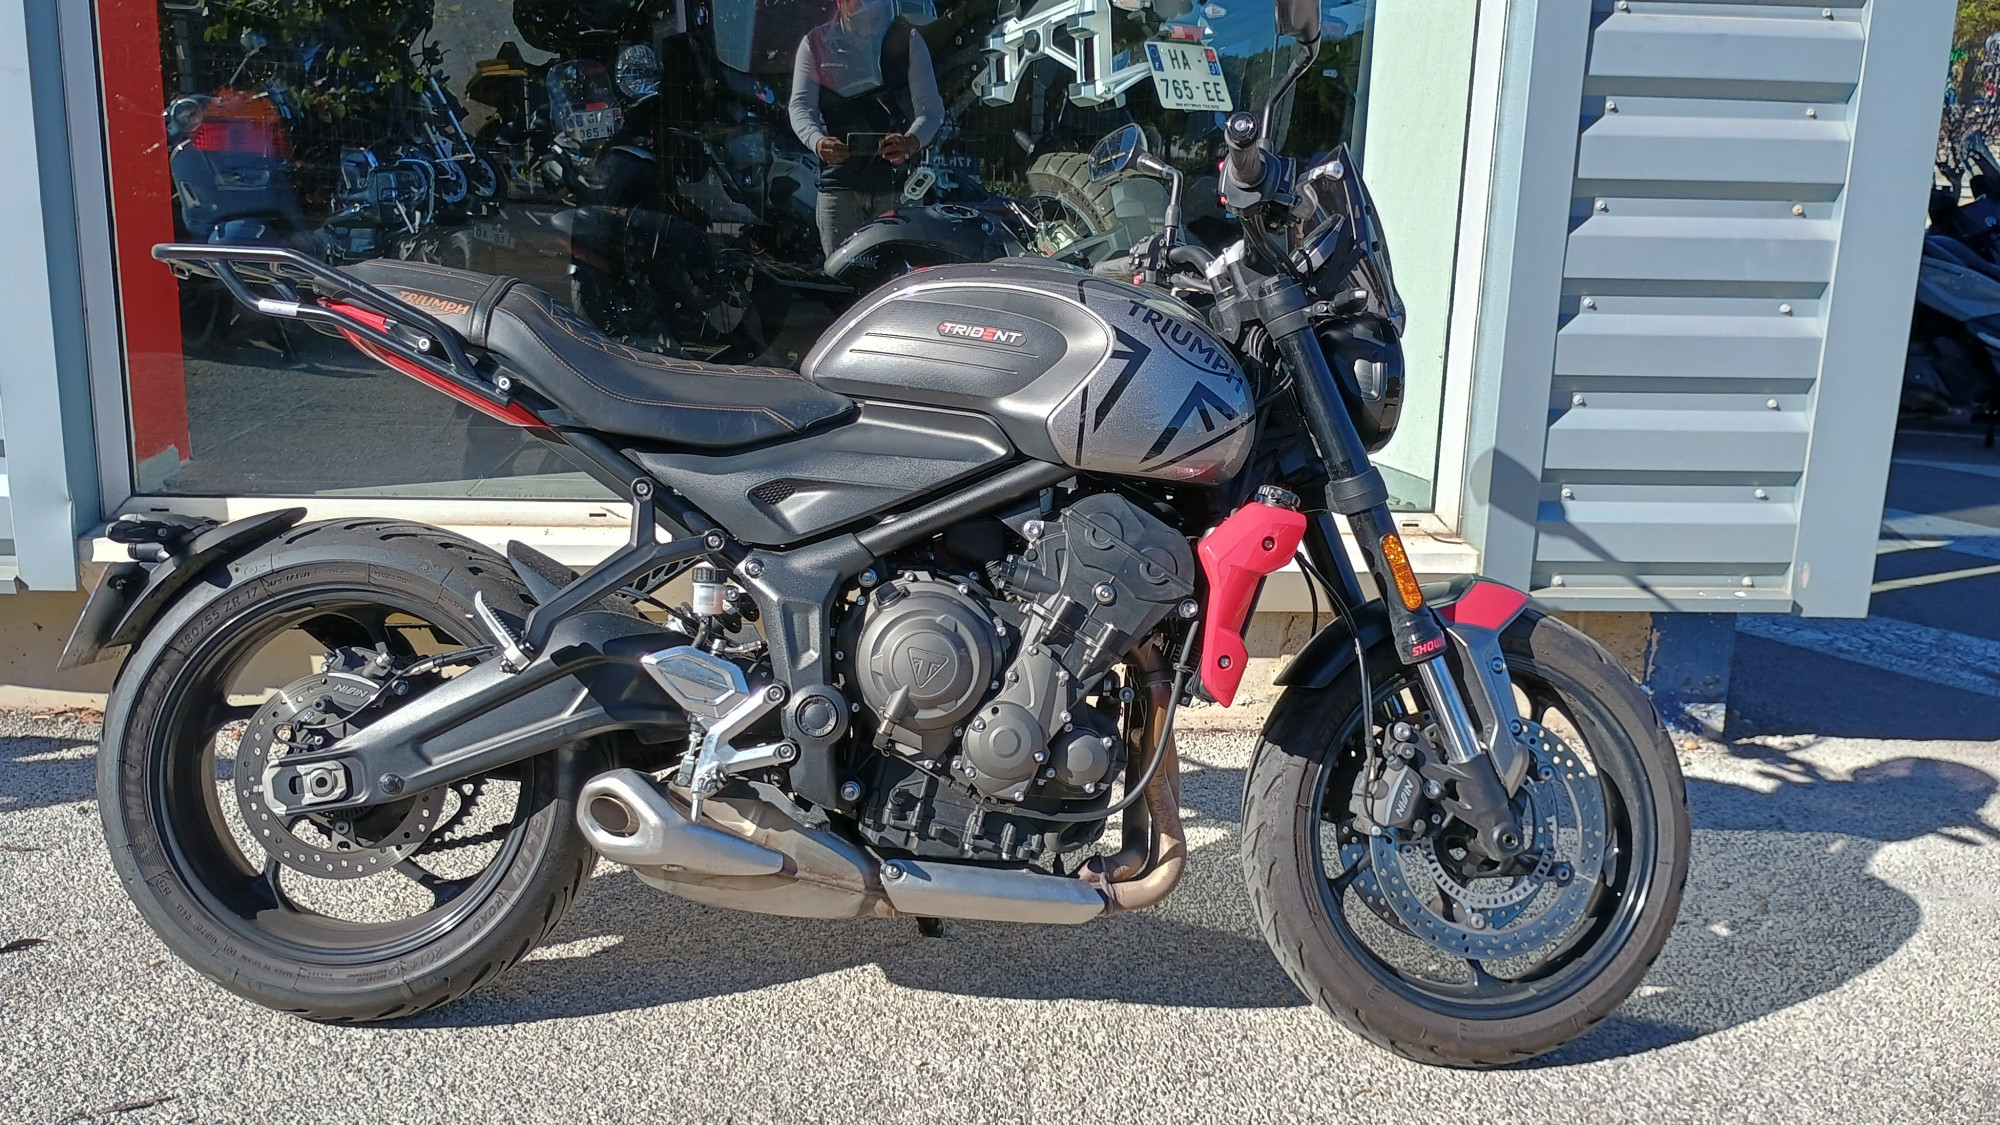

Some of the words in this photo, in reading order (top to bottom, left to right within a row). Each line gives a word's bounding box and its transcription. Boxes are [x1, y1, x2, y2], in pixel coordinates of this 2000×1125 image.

[1209, 62, 1220, 75] 31
[1160, 78, 1226, 103] 765-EE
[400, 290, 471, 317] TRIUMPH
[939, 322, 1023, 343] TRIDENT
[1128, 299, 1243, 394] TRIUMPH
[180, 610, 220, 651] 180/55
[223, 597, 242, 613] ZR
[245, 586, 259, 600] 17
[125, 668, 172, 821] MICHELIN
[472, 892, 505, 932] ROAD
